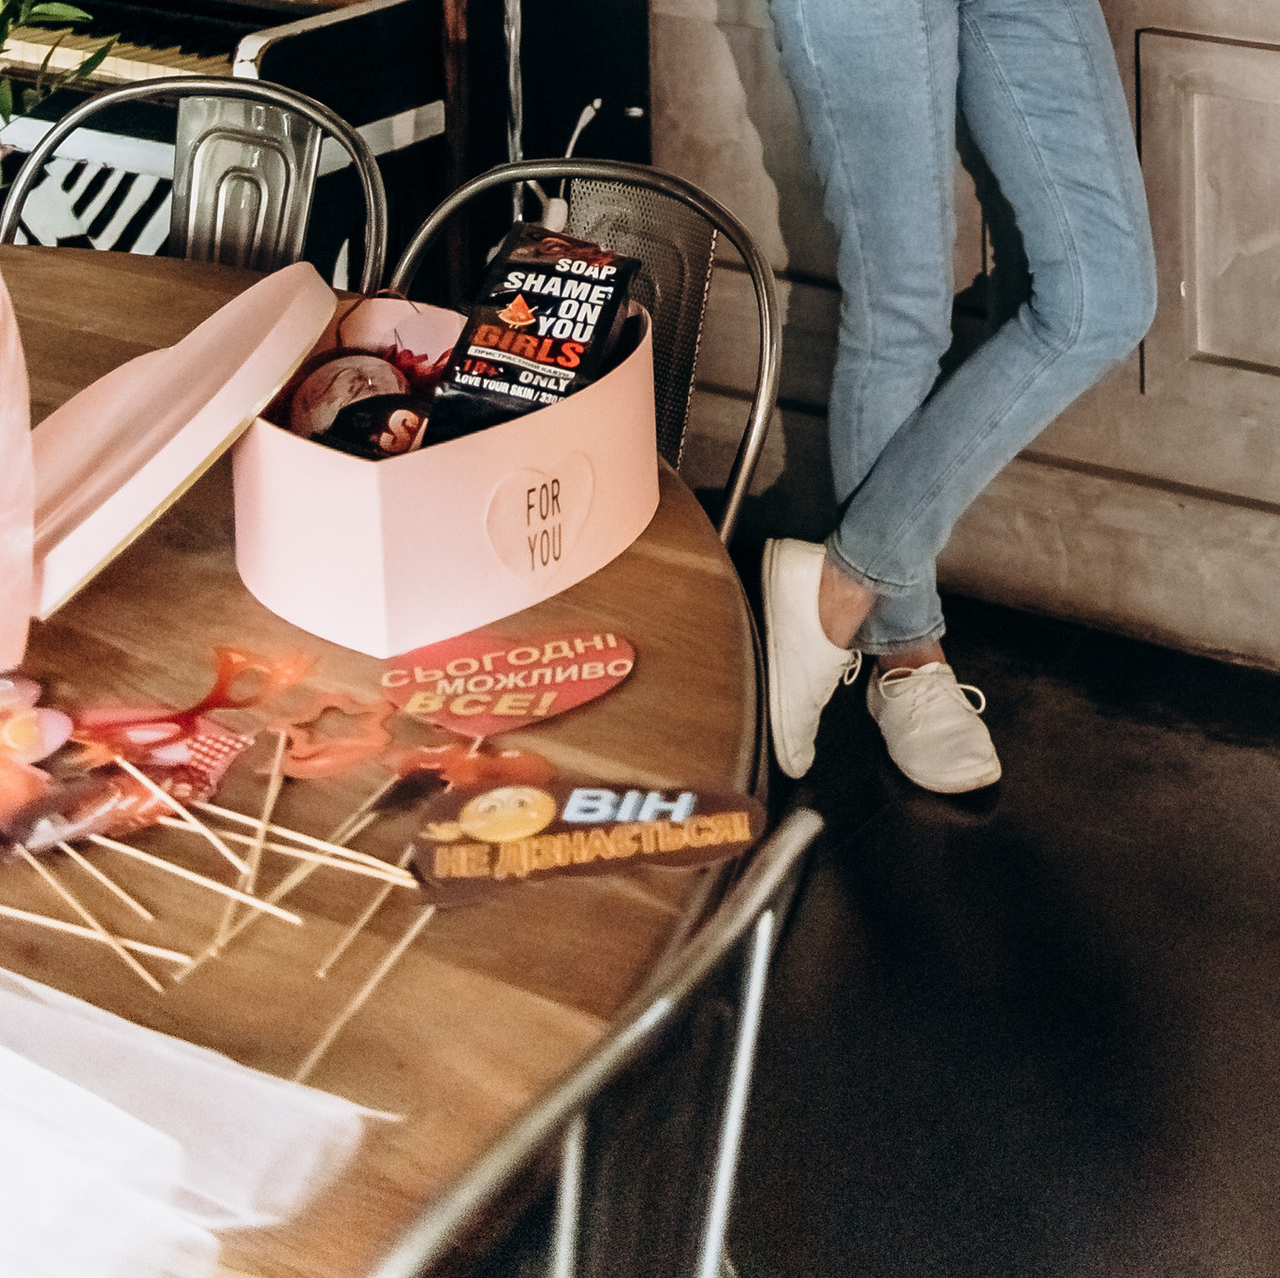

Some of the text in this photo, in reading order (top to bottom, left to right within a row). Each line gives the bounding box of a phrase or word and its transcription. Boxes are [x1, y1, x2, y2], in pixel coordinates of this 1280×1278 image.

[555, 258, 617, 281] SOAP
[503, 271, 614, 305] SHAME
[537, 315, 595, 343] YOU
[558, 299, 602, 325] ON
[472, 324, 585, 368] GIRLS
[454, 372, 481, 387] LOVE
[482, 378, 510, 393] YOUR
[510, 384, 534, 401] SKIN
[518, 370, 570, 392] ONLY
[526, 478, 561, 527] FOR
[527, 523, 562, 571] YOU
[380, 633, 618, 688] СЬОГОДНІ
[436, 658, 634, 695] МОЖЛИВО
[402, 690, 559, 717] ВСЕ!
[562, 787, 697, 823] ВІН
